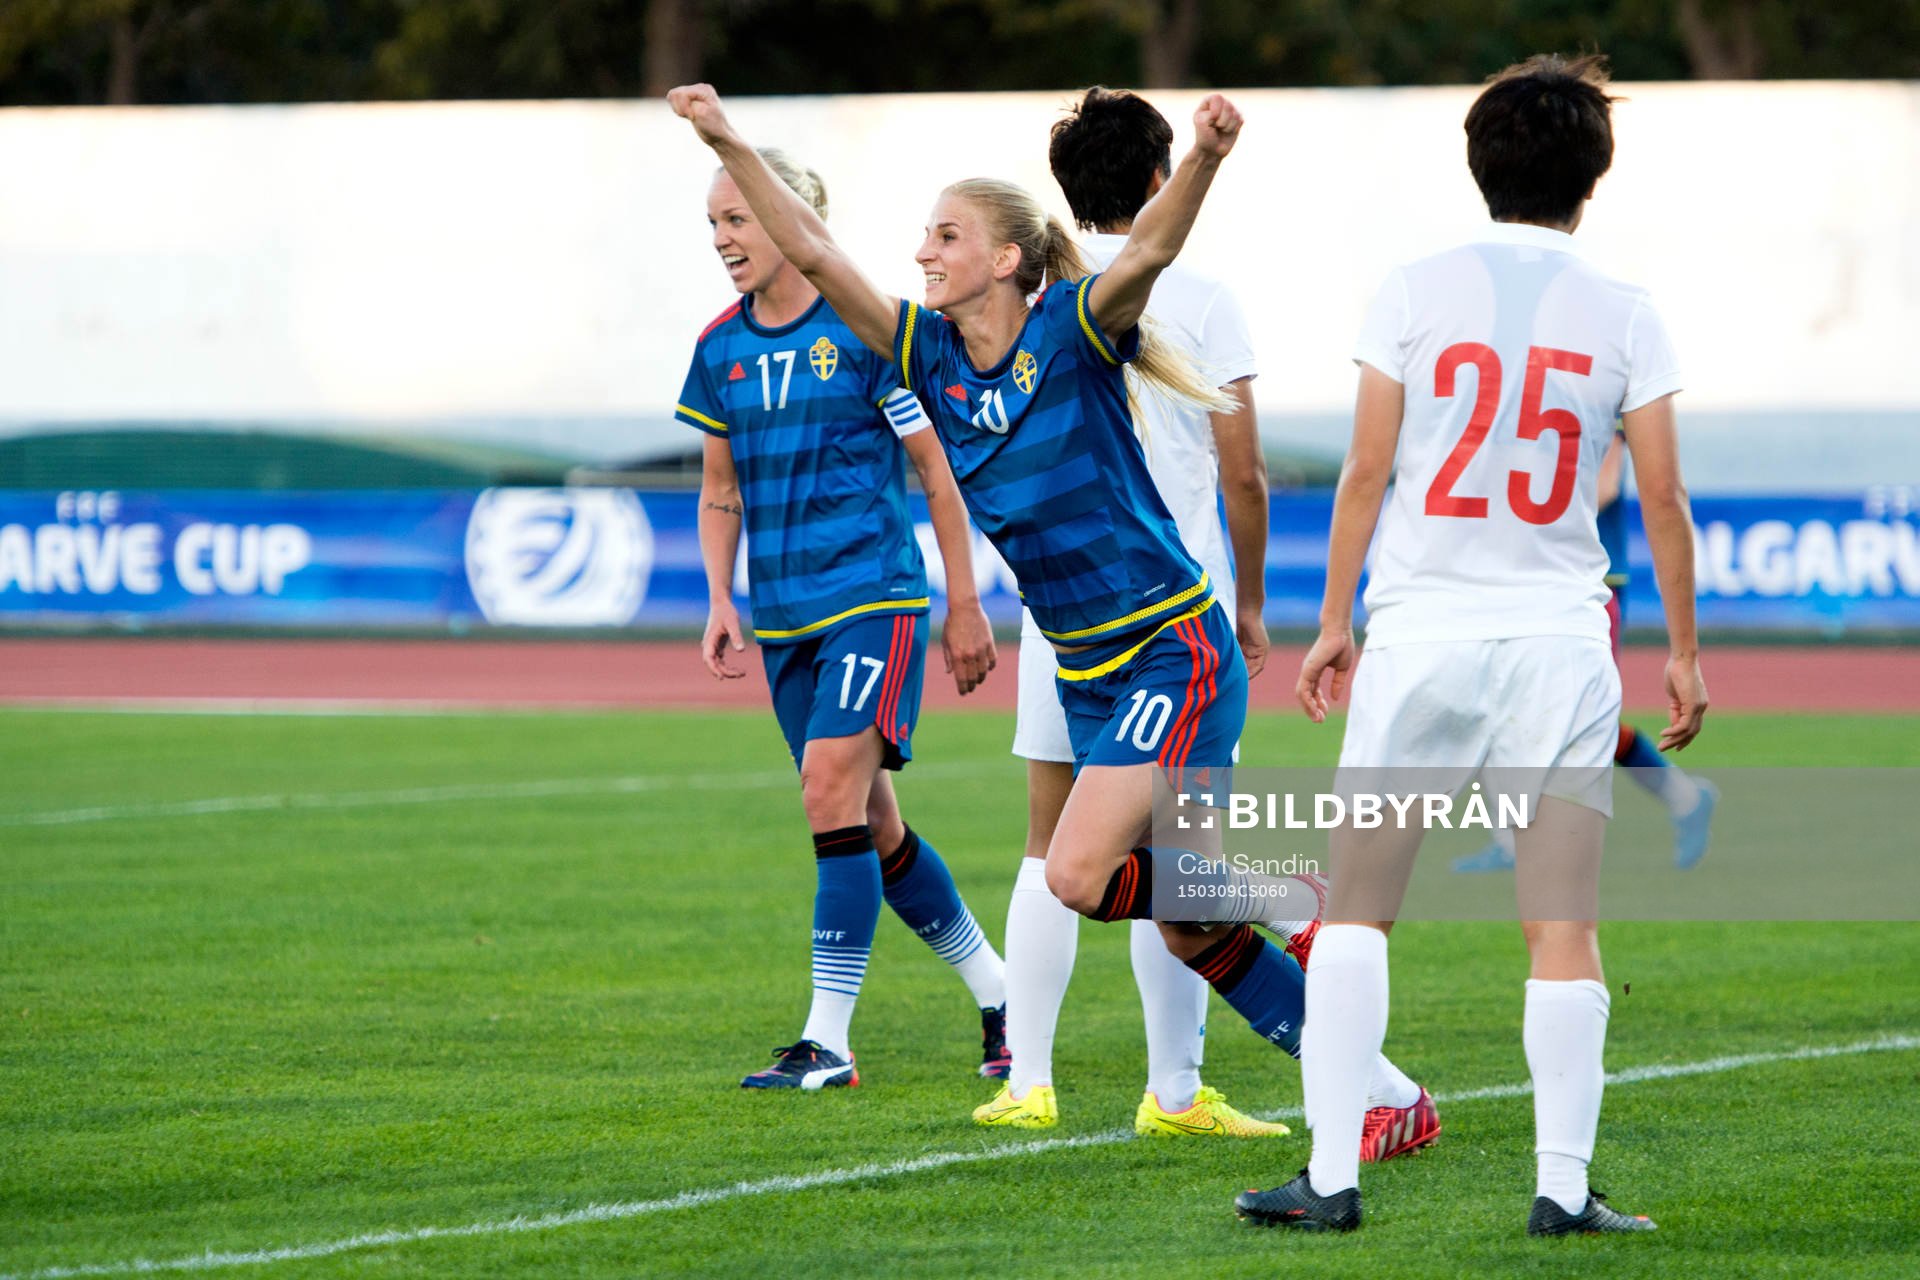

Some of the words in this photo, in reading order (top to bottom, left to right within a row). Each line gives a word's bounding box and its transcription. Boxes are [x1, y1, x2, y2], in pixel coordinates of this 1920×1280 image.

[756, 350, 796, 411] 17
[1424, 342, 1593, 525] 25
[174, 522, 311, 596] CUP
[839, 653, 885, 712] 17
[1115, 689, 1173, 752] 10
